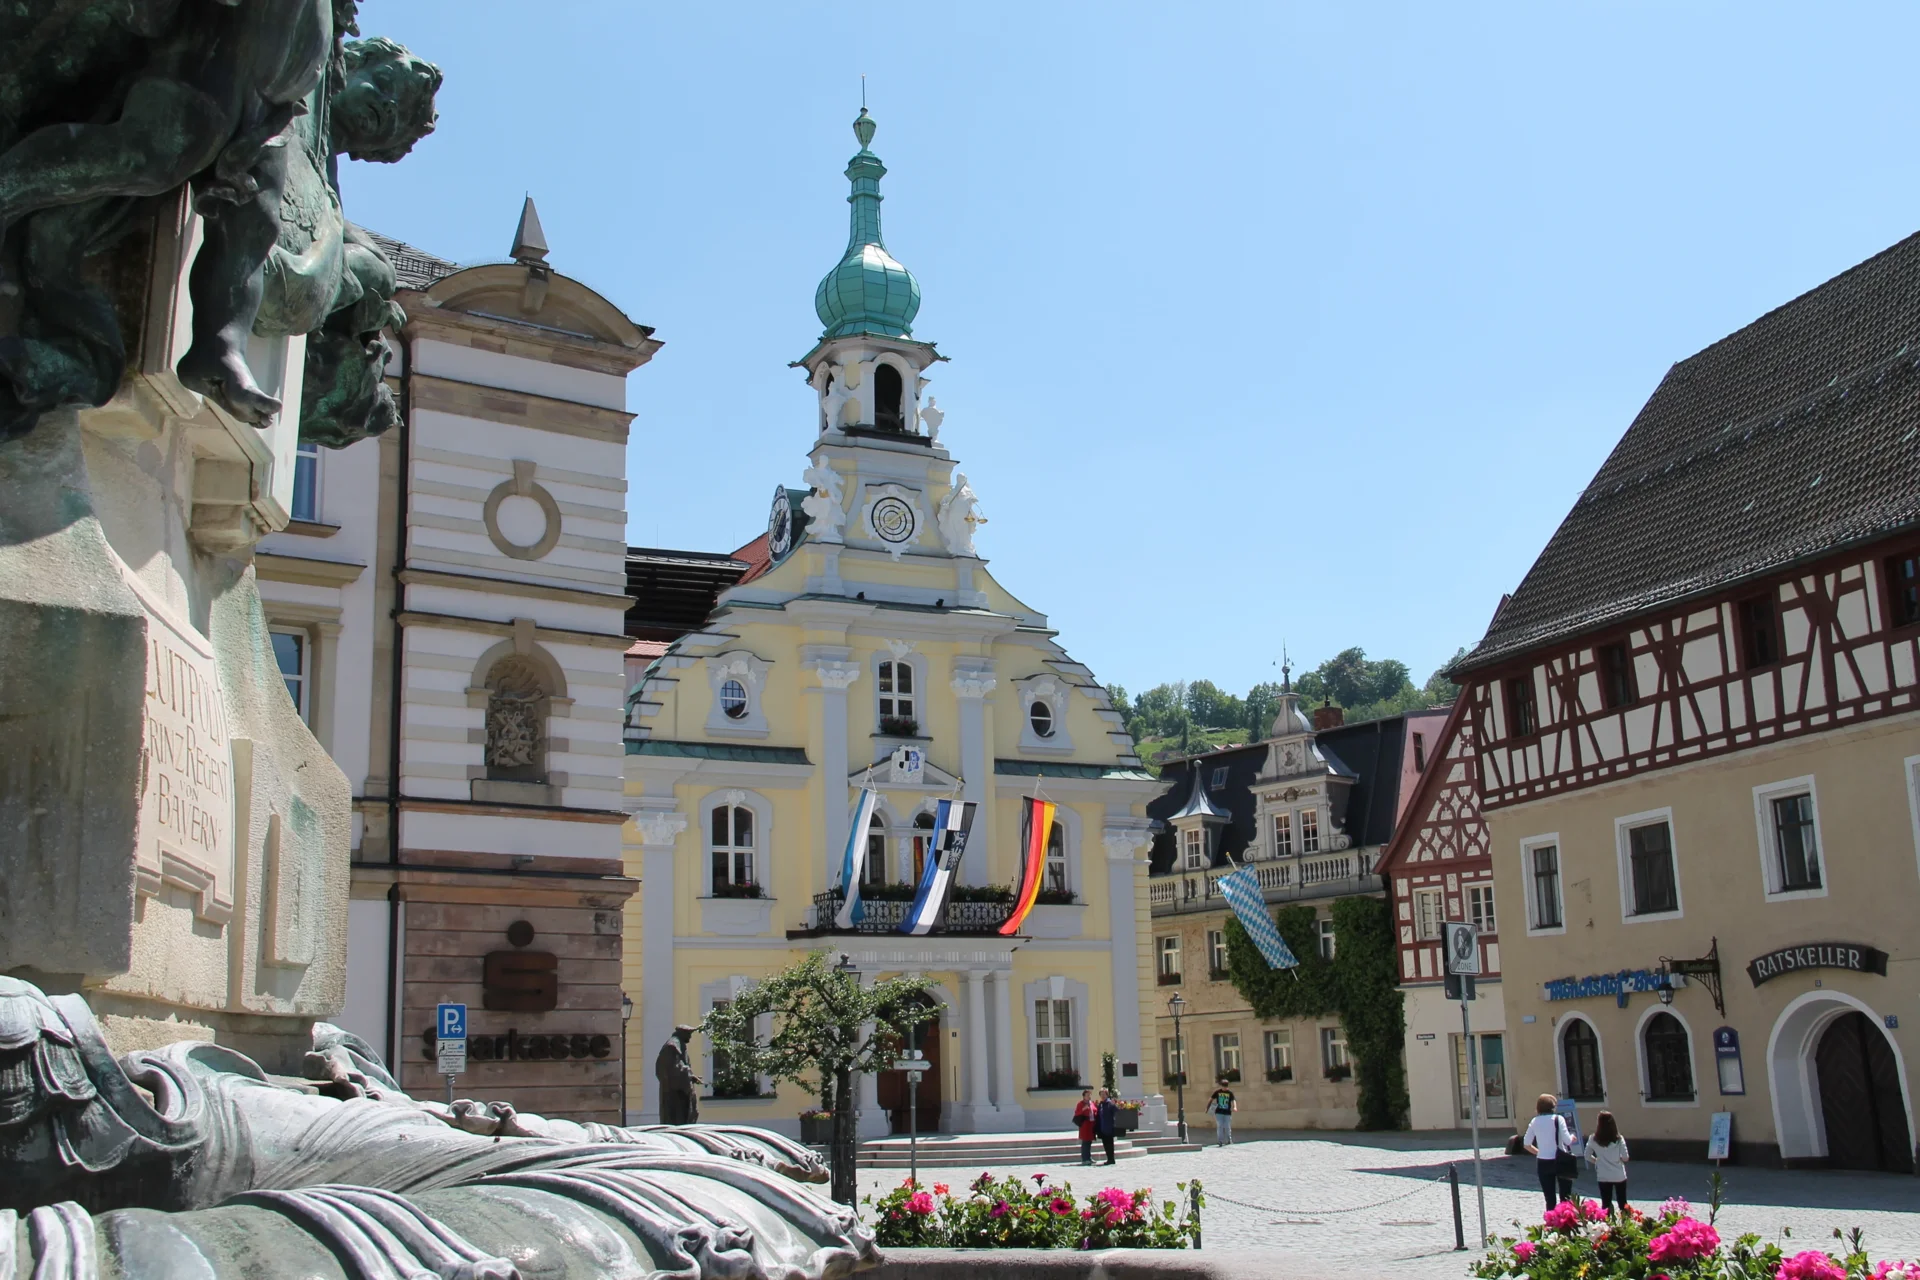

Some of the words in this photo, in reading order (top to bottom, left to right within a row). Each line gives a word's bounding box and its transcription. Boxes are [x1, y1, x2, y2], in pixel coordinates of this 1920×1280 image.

[146, 639, 223, 746] UITPOLD
[1457, 962, 1473, 971] ZONE
[1755, 946, 1861, 979] RATSKELLER
[444, 1008, 460, 1035] P
[422, 1027, 611, 1061] Sarkasse
